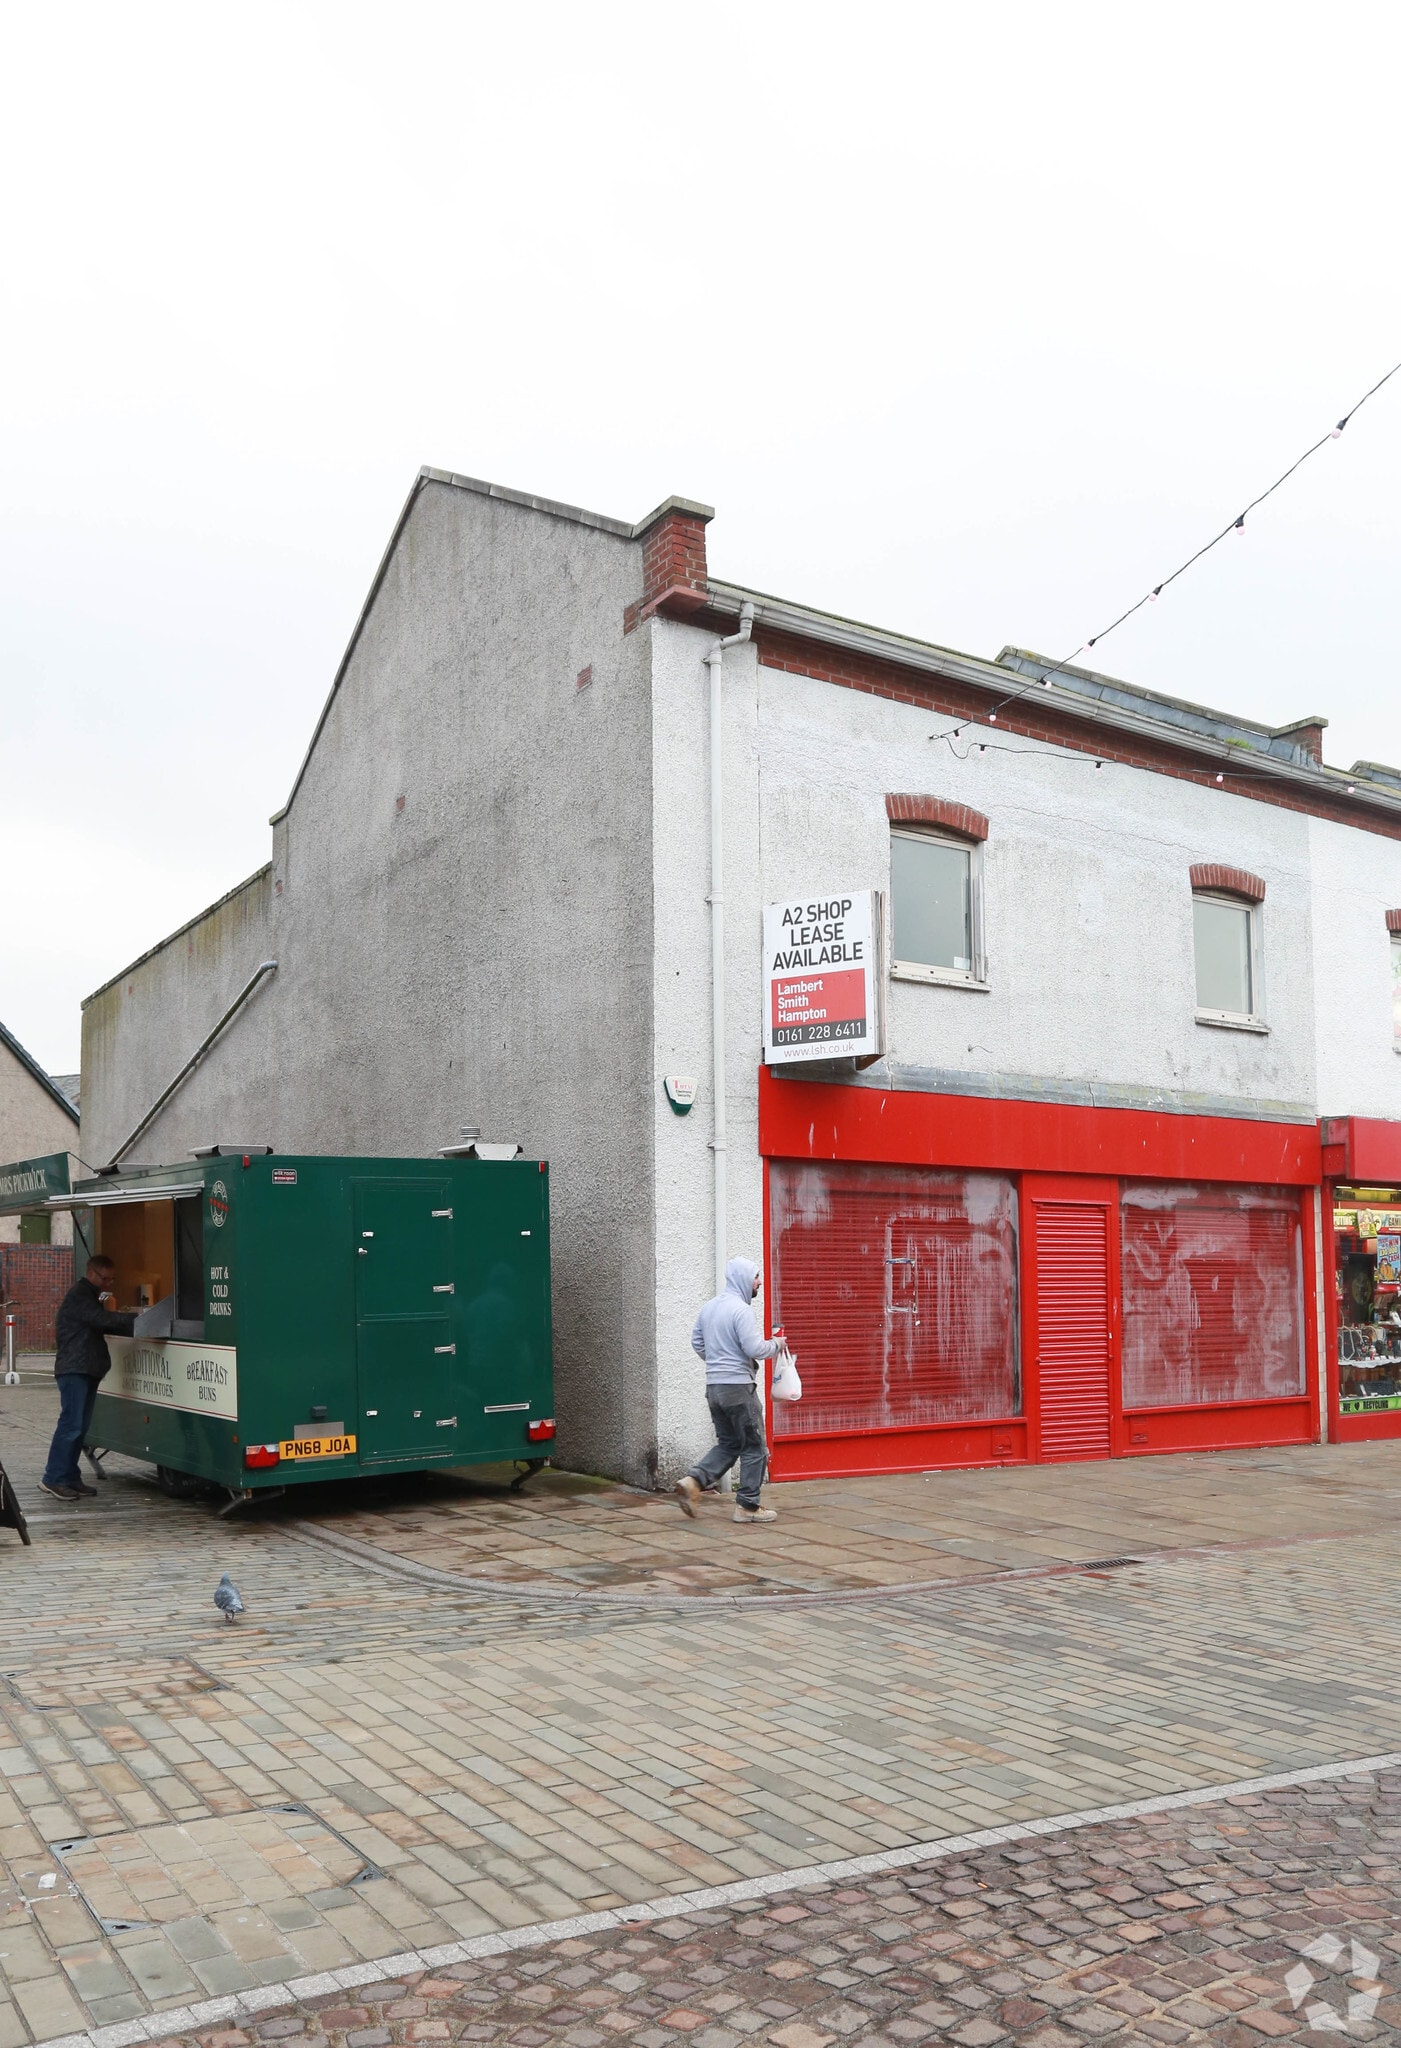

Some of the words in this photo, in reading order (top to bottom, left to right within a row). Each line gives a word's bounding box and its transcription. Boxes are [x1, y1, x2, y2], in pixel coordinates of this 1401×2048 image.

[782, 906, 803, 927] A2
[807, 899, 852, 922] SHOP
[791, 922, 844, 947] LEASE
[773, 941, 863, 971] AVAILABLE
[777, 979, 823, 996] Lambert
[777, 994, 809, 1009] Smith
[778, 1008, 827, 1023] Hampton
[777, 1028, 802, 1043] 0161
[808, 1025, 831, 1040] 228
[835, 1022, 861, 1037] 6411
[784, 1041, 855, 1058] www.lsh.co.uk
[211, 1266, 223, 1280] HOT
[224, 1266, 229, 1279] &
[212, 1284, 229, 1298] COLD
[210, 1302, 232, 1316] DRINKS
[186, 1360, 228, 1386] BREAKFAST
[143, 1380, 174, 1398] POTATOES
[198, 1385, 217, 1402] BUNS
[285, 1441, 321, 1456] PN68
[325, 1438, 351, 1453] JOA
